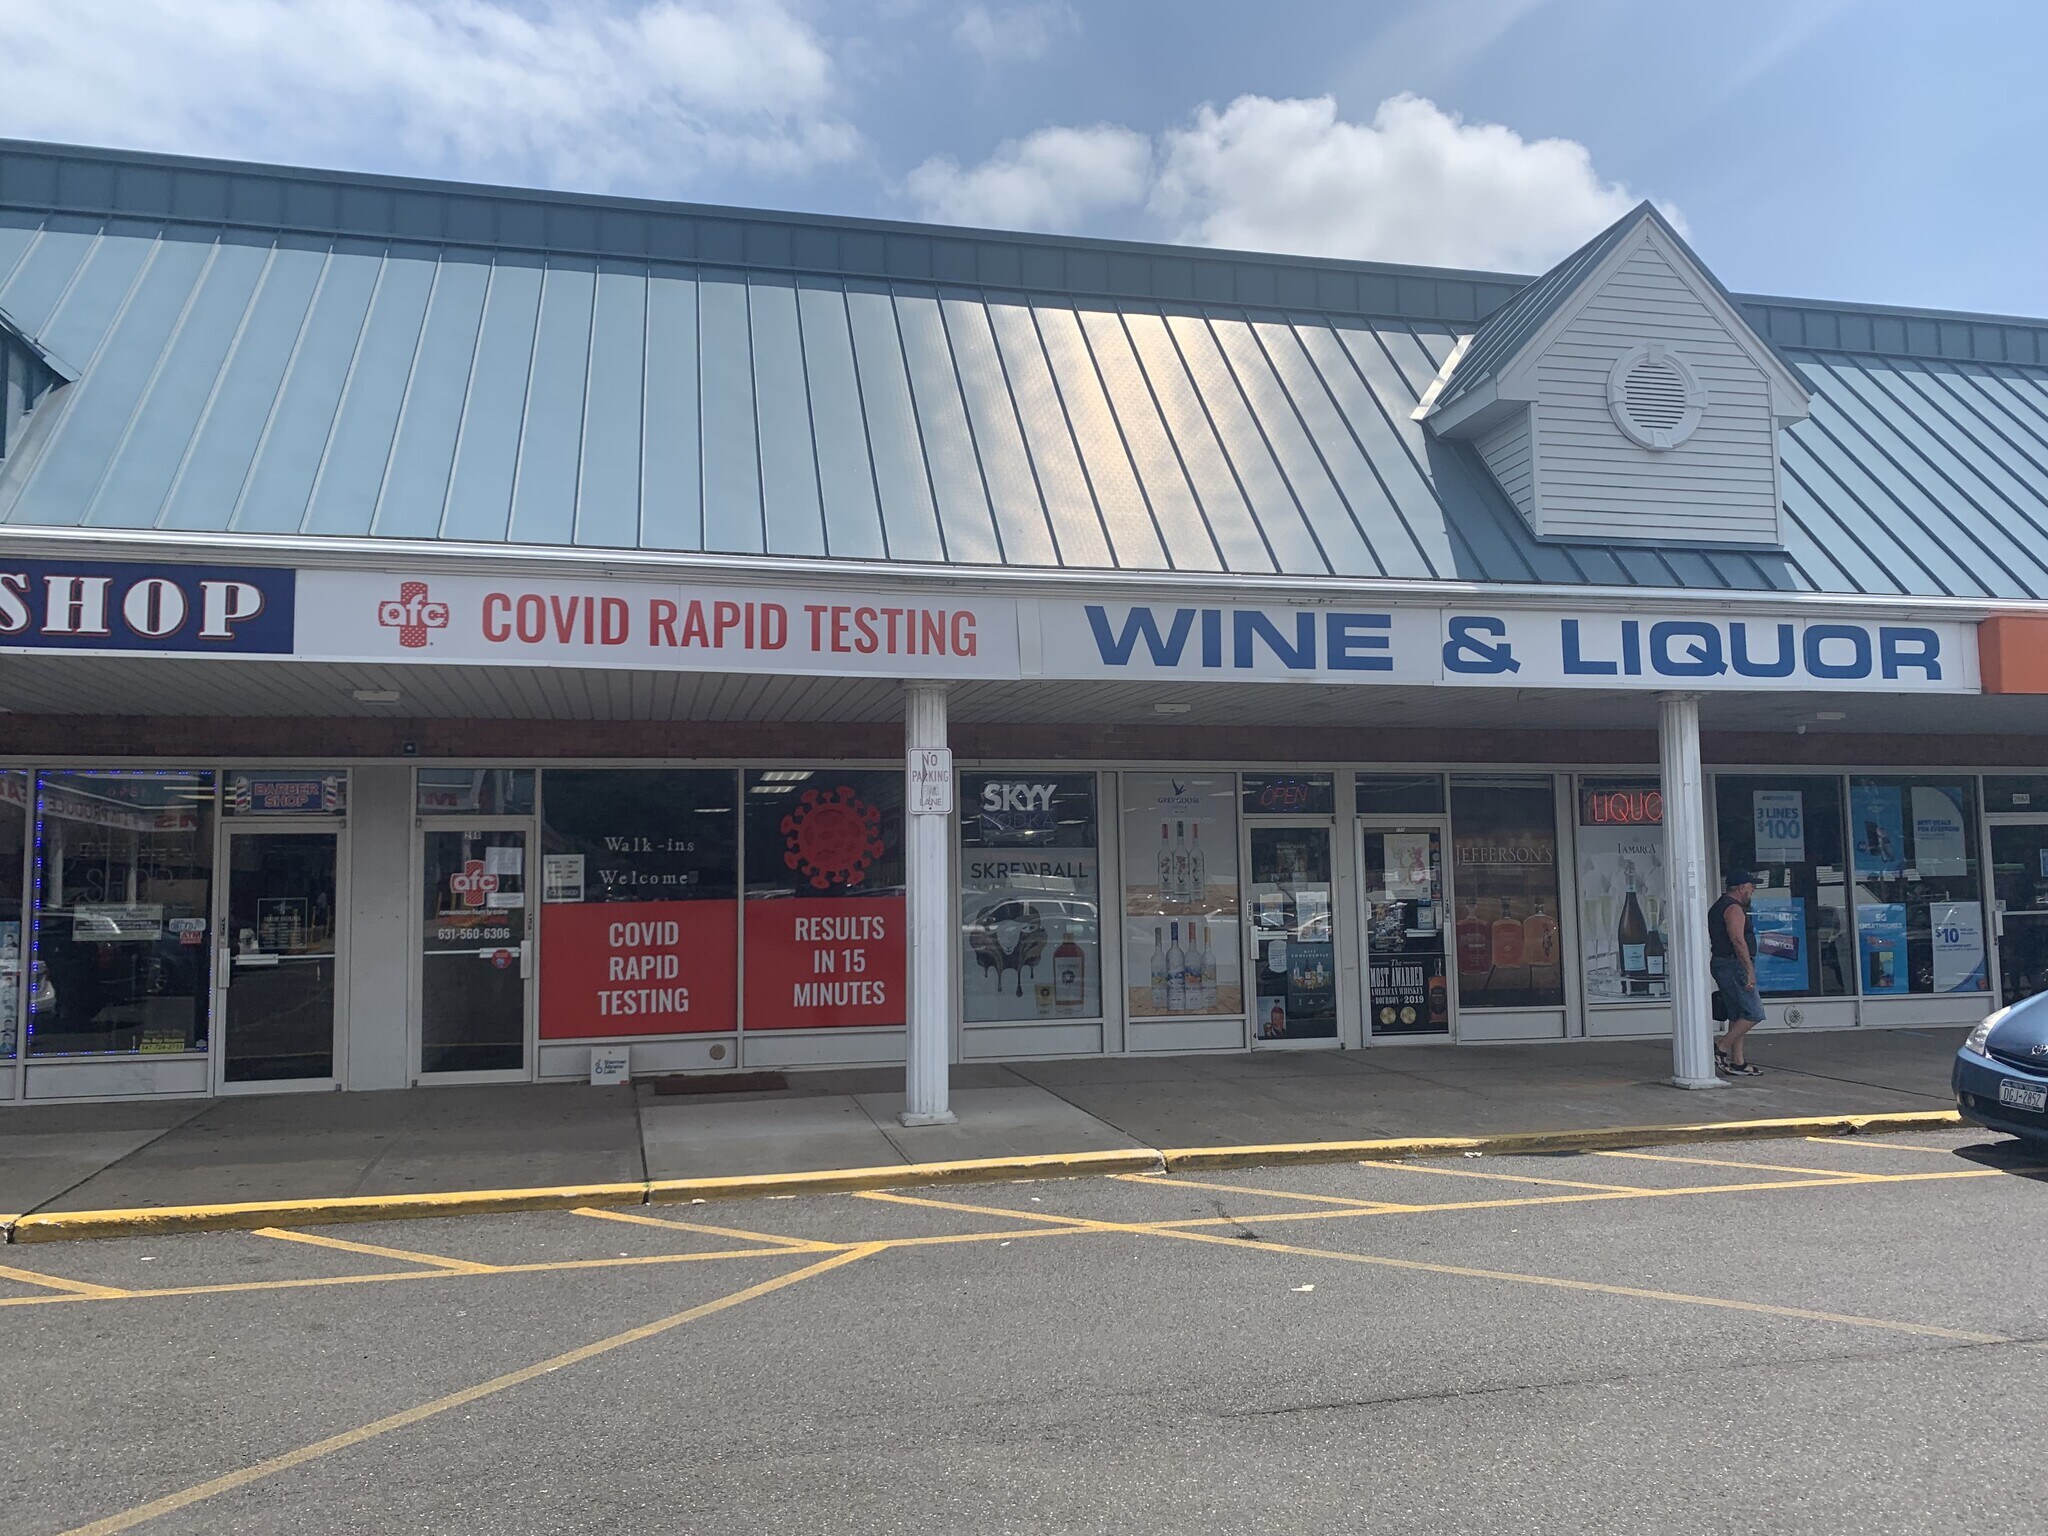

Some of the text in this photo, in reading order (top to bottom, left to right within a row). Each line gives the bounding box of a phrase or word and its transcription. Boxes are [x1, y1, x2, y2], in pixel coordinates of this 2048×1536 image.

[0, 573, 264, 639] SHOP
[382, 593, 448, 626] afc
[482, 592, 977, 656] COVID RAPID TESTING
[1084, 605, 1942, 681] WINE & LIQUOR
[922, 754, 938, 766] NO
[254, 783, 319, 796] BARBER
[983, 783, 1058, 811] SKYY
[1261, 785, 1308, 806] OPEN
[264, 795, 309, 808] SHOP
[919, 798, 942, 806] LANE
[982, 813, 1056, 829] VODKA
[1757, 807, 1799, 819] 3 LINES
[1757, 819, 1801, 839] $100
[1456, 845, 1553, 866] JEFFERSON'S
[454, 868, 500, 891] afc
[599, 869, 688, 885] Welcome
[971, 862, 1089, 879] SKREWBALL
[1875, 913, 1886, 922] 5G
[438, 928, 510, 939] 631-560-6306
[609, 921, 679, 947] COVID
[795, 916, 885, 941] RESULTS
[1935, 927, 1960, 943] $10
[609, 954, 679, 981] RAPID
[814, 948, 866, 973] IN 15
[1370, 966, 1424, 987] MOST AWARDED
[597, 987, 689, 1015] TESTING
[793, 980, 886, 1007] MINUTES
[1371, 987, 1423, 996] AMERICAN WHISKEY
[1375, 995, 1424, 1004] BOURBON 2019
